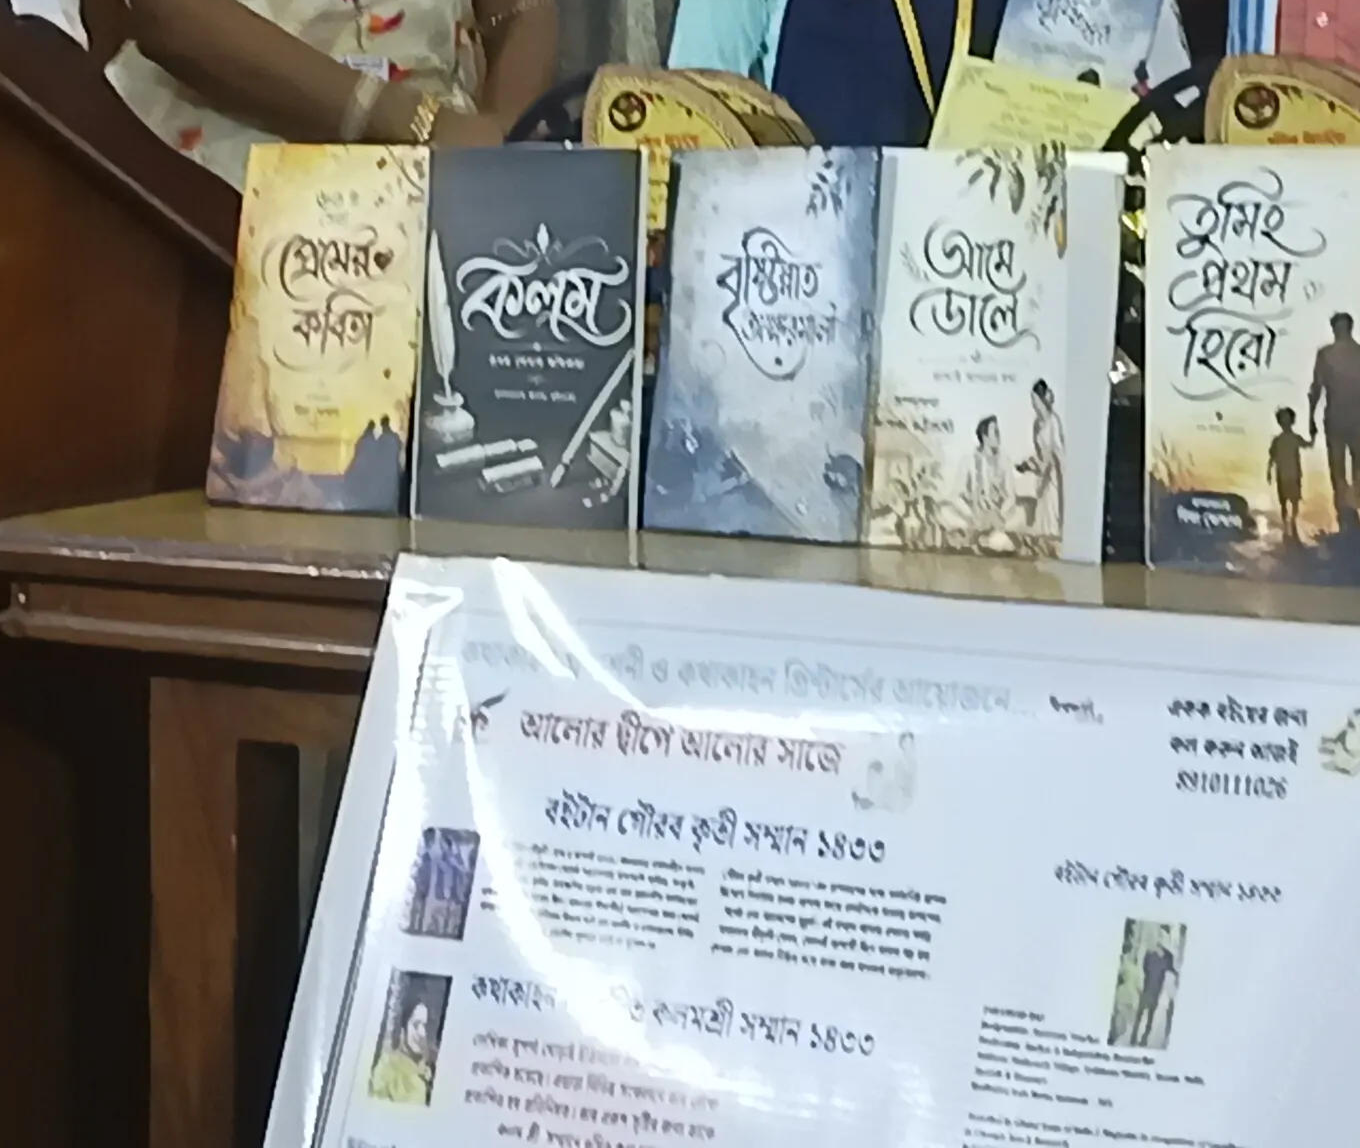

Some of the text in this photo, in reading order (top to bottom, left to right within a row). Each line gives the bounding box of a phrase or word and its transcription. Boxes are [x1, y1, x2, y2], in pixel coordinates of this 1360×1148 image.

[278, 226, 380, 300] প্রেমের
[1168, 257, 1299, 312] প্রথম
[292, 292, 385, 355] কবিতা
[456, 255, 632, 347] কলম
[909, 286, 1040, 350] ডালে
[1167, 307, 1288, 401] হিরো
[520, 709, 609, 750] আলোর
[681, 726, 768, 767] আলোর
[777, 736, 846, 776] সাজে
[617, 797, 685, 841] গৌরব
[816, 828, 886, 864] ১৪৩৩
